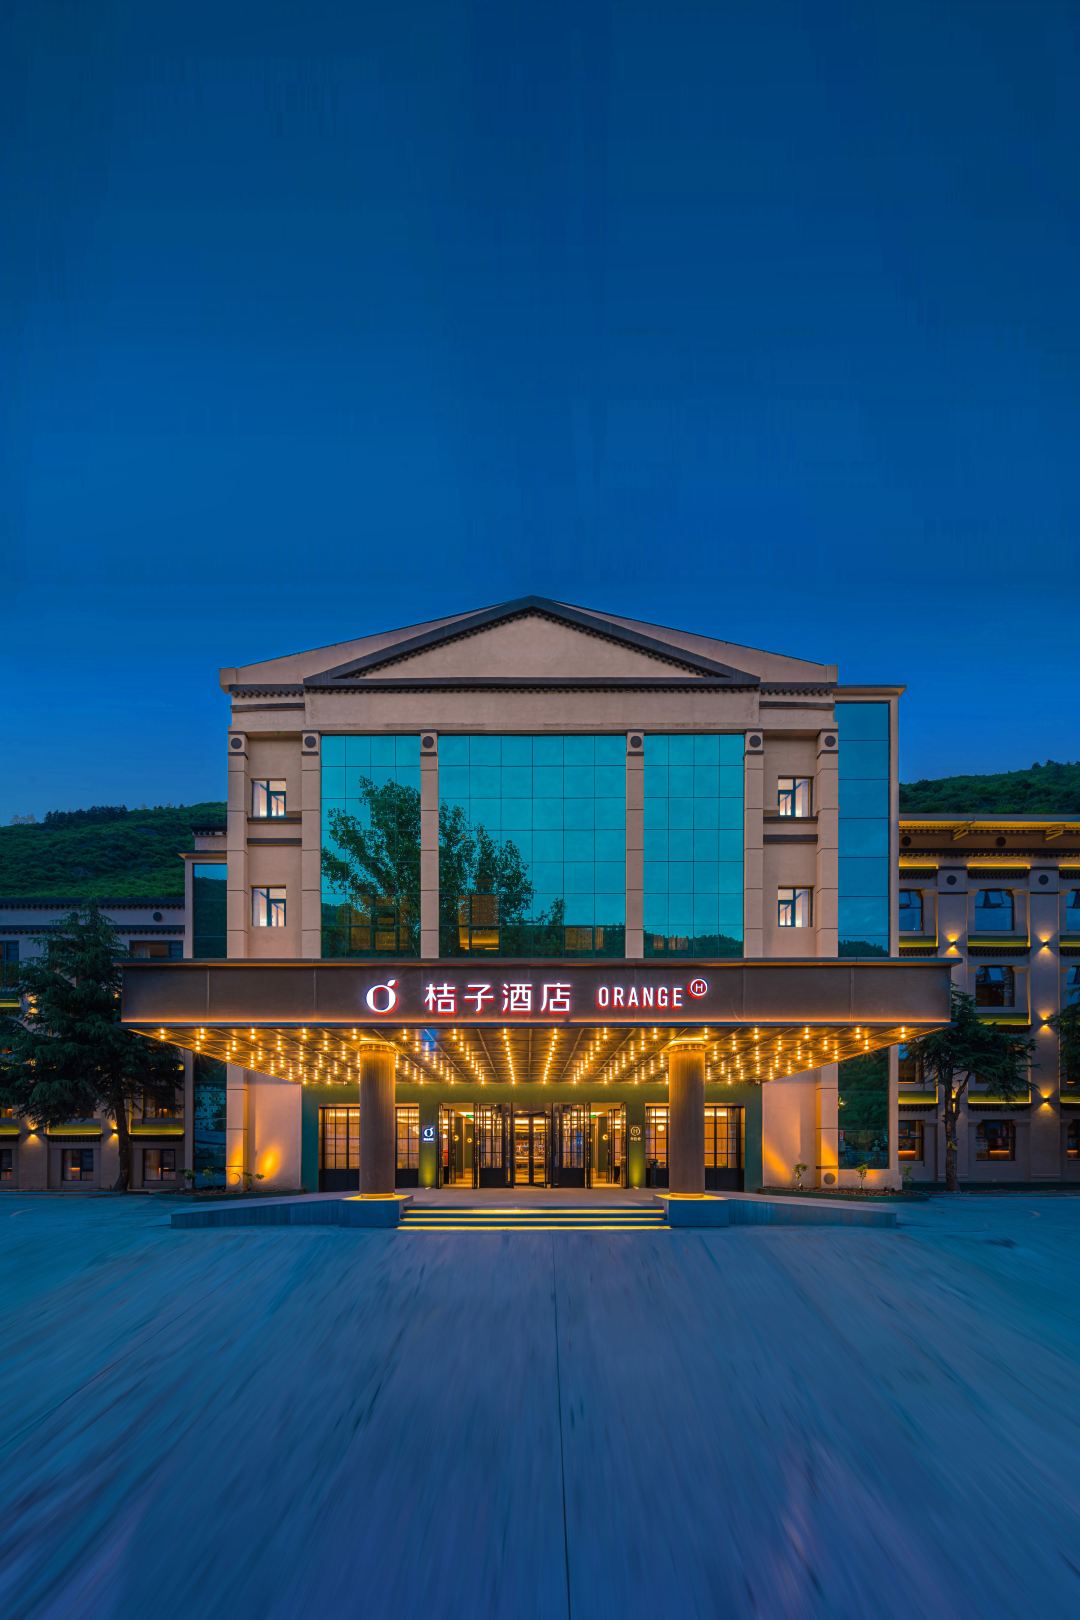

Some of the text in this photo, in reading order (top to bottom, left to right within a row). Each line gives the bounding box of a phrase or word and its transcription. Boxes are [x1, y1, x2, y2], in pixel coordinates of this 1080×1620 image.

[424, 983, 571, 1012] 桔子酒店
[598, 987, 683, 1006] ORANGE
